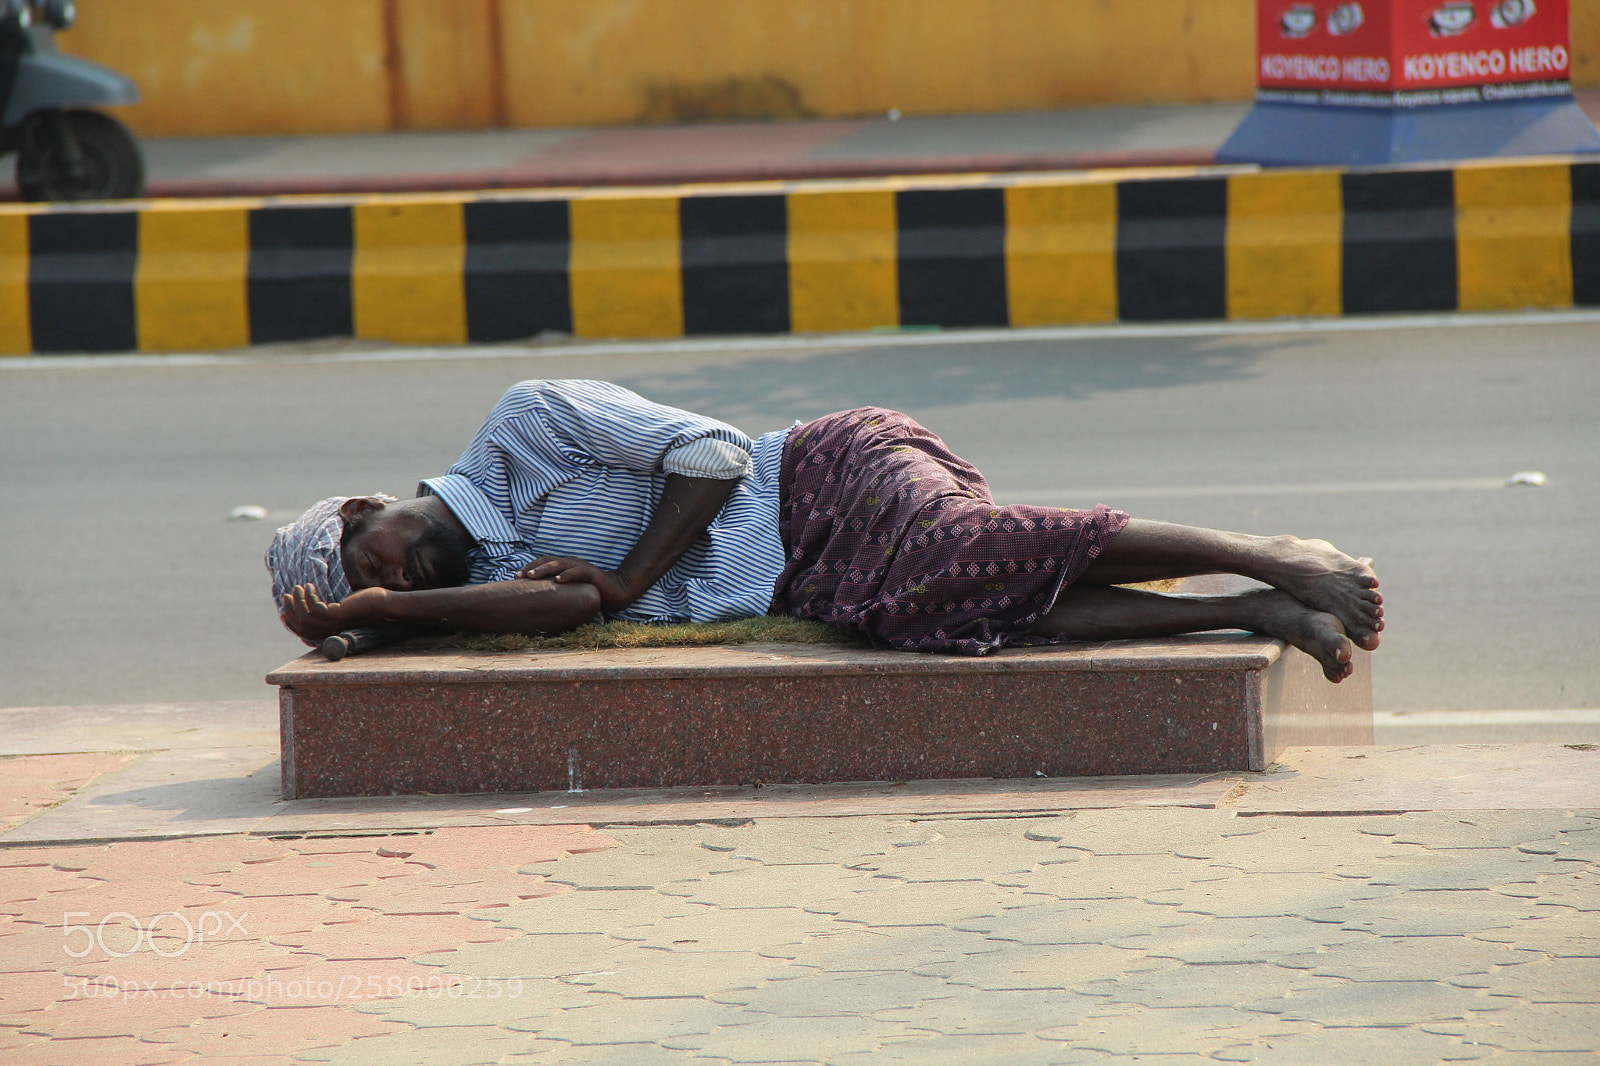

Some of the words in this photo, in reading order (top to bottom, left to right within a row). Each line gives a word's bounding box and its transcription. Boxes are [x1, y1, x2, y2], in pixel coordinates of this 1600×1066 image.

[1262, 55, 1340, 80] KOYENCO
[1343, 57, 1390, 82] HERO
[1404, 49, 1505, 80] KOYENCO
[1510, 45, 1568, 73] HERO
